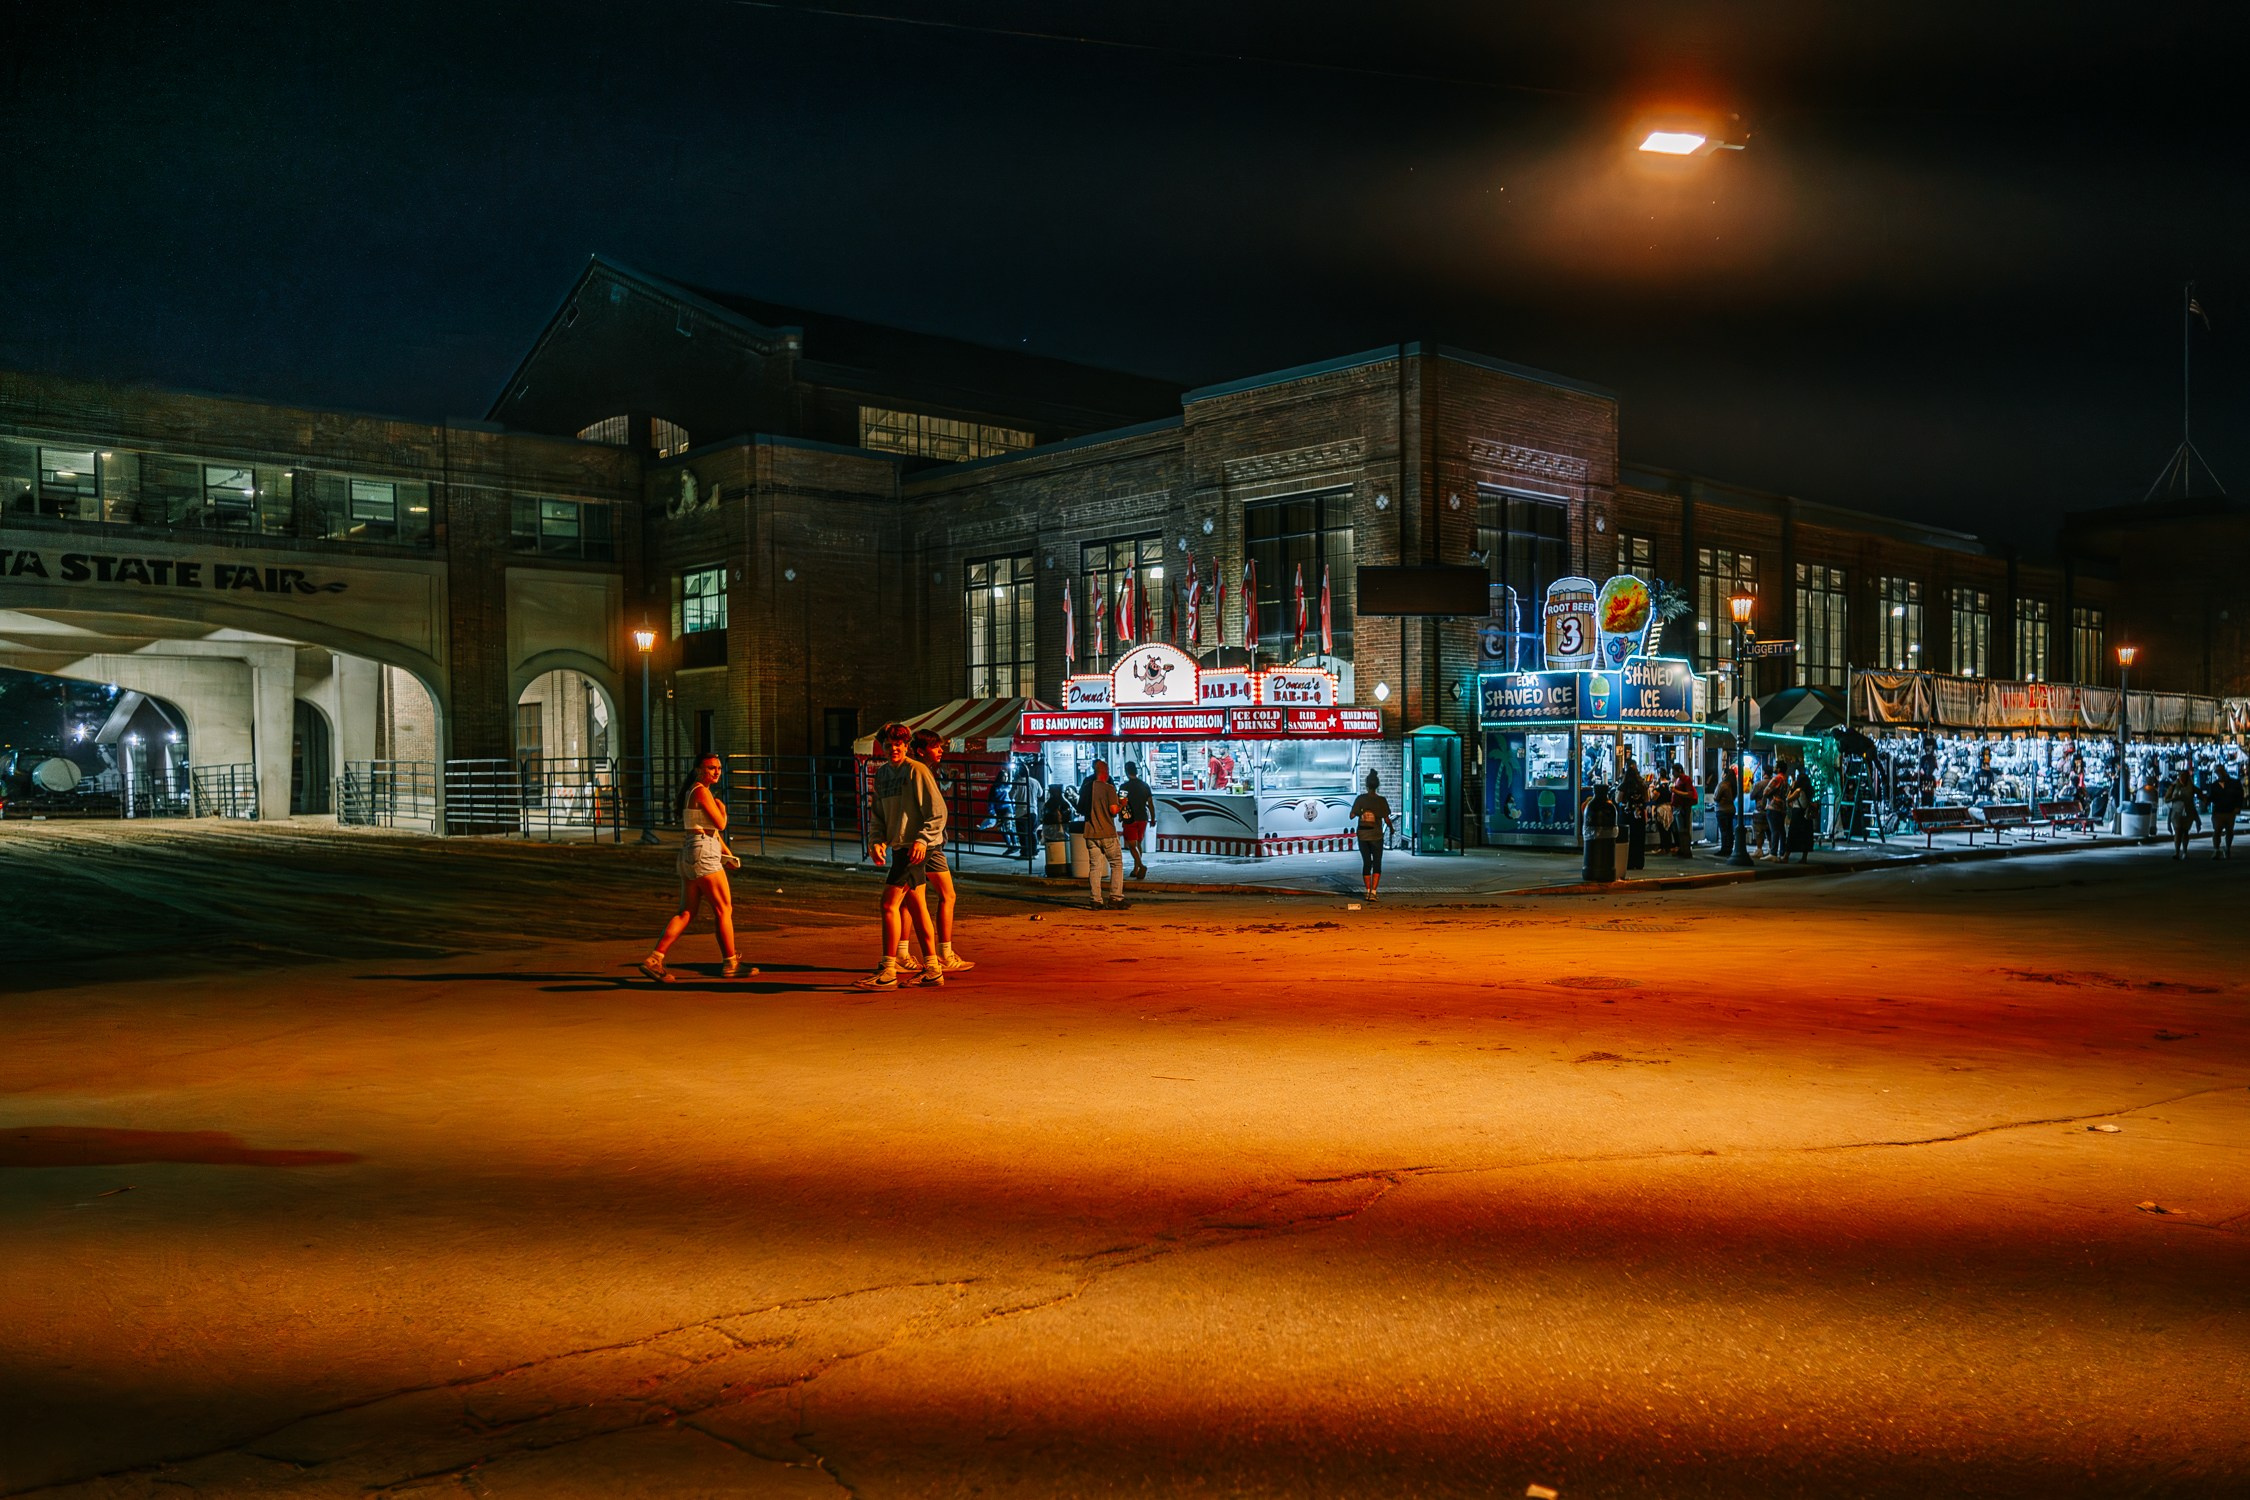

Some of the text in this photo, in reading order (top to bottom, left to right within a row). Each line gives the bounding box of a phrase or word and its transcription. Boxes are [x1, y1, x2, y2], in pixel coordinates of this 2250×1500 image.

[60, 552, 202, 587] STATE
[214, 563, 328, 594] FAIR
[1547, 602, 1594, 614] ROOT BEER
[1746, 643, 1783, 654] LIGGETT
[1625, 665, 1673, 686] SHAVED
[1273, 675, 1320, 690] Donna's
[1202, 682, 1251, 700] BAR-B-Q
[1273, 691, 1321, 704] BAR-B-Q
[1485, 686, 1573, 706] SHAVED ICE
[1640, 689, 1660, 708] ICE
[1120, 714, 1223, 729] SHAVED PORK TENDERLOIN
[1232, 711, 1280, 721] ICE COLD
[1299, 711, 1316, 720] RIB
[1340, 711, 1378, 720] SHAVED PORK
[1030, 717, 1104, 730] RIB SANDWICHES
[1236, 720, 1277, 731] DRINKS
[1288, 721, 1327, 730] SANDWICH
[1343, 721, 1378, 730] TENDERLOIN
